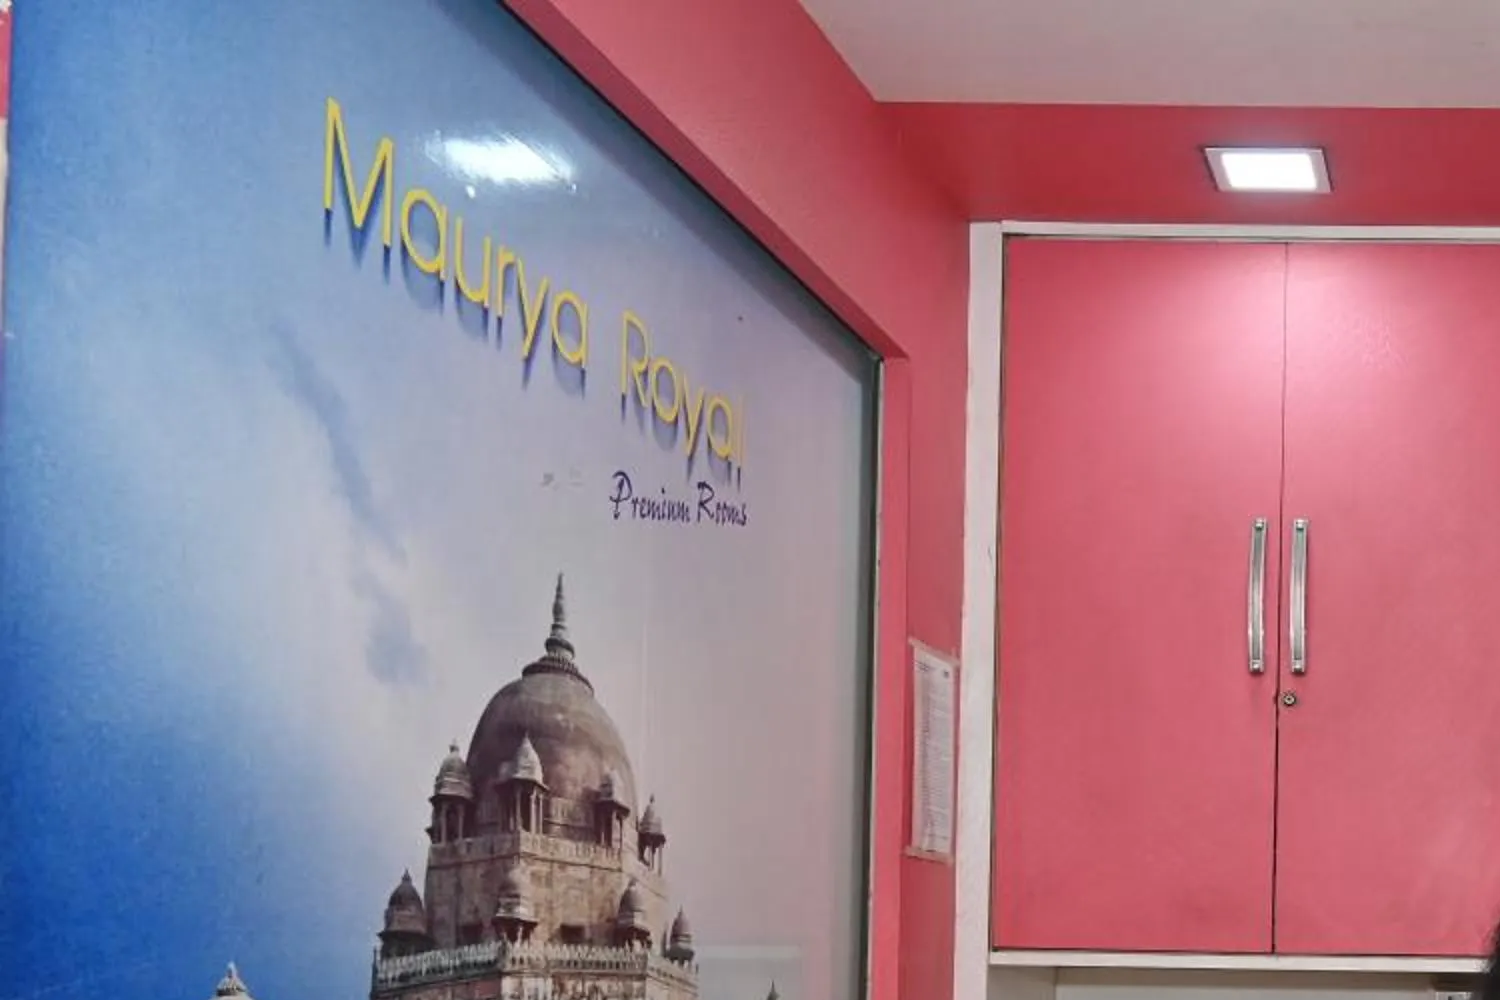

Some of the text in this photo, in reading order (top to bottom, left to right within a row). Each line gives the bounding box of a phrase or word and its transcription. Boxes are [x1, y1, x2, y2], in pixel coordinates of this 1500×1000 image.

[323, 97, 746, 468] Maurya Royal
[609, 470, 747, 526] Premium Rooms
